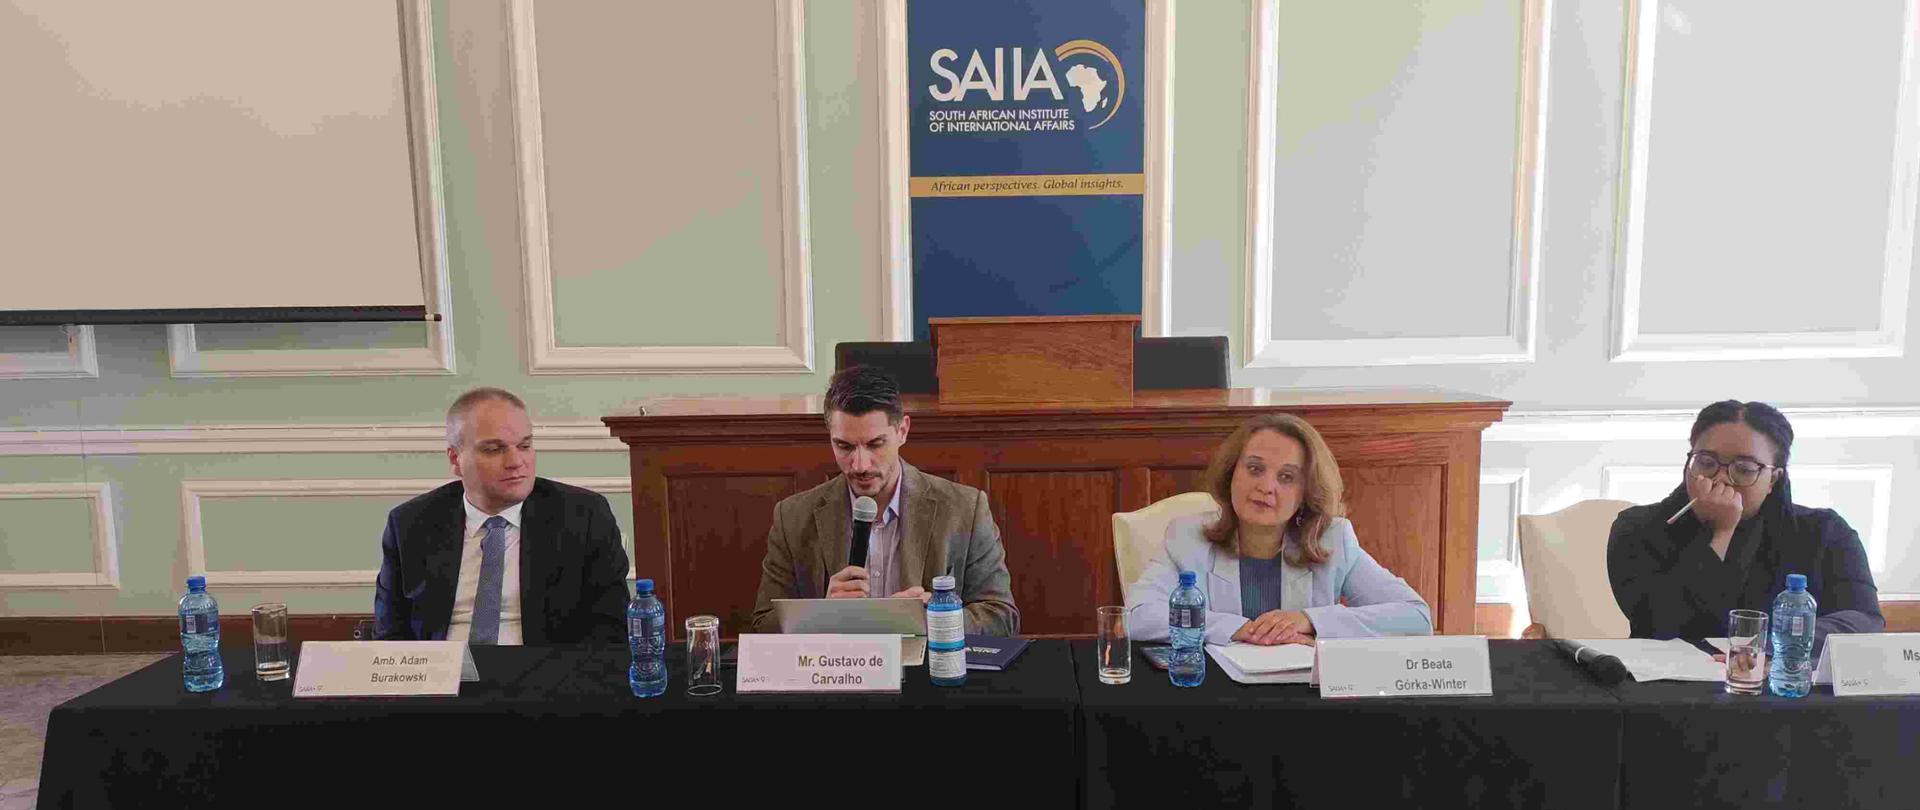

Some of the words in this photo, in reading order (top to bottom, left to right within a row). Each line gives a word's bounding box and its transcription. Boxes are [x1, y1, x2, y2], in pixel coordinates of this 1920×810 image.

[928, 47, 1064, 102] SAIIA
[929, 110, 966, 121] SOUTH
[969, 109, 1016, 120] AFRICAN
[1018, 108, 1069, 119] INSTITUTE
[929, 121, 945, 132] OF
[947, 120, 1031, 132] INTERNATIONAL
[1035, 120, 1075, 131] AFFAIRS
[931, 181, 970, 192] African
[973, 180, 1040, 191] perspectives.
[1043, 179, 1078, 190] Global
[1080, 179, 1124, 191] insights.
[372, 656, 397, 666] Amb.
[400, 656, 428, 666] Adam
[798, 655, 815, 667] Mr.
[818, 655, 866, 667] Gustavo
[869, 655, 883, 667] de
[1406, 659, 1418, 670] Dr
[1422, 659, 1453, 670] Beata
[371, 672, 427, 683] Burakowski
[811, 673, 862, 685] Carvalho
[1395, 679, 1467, 691] Górka-Winter
